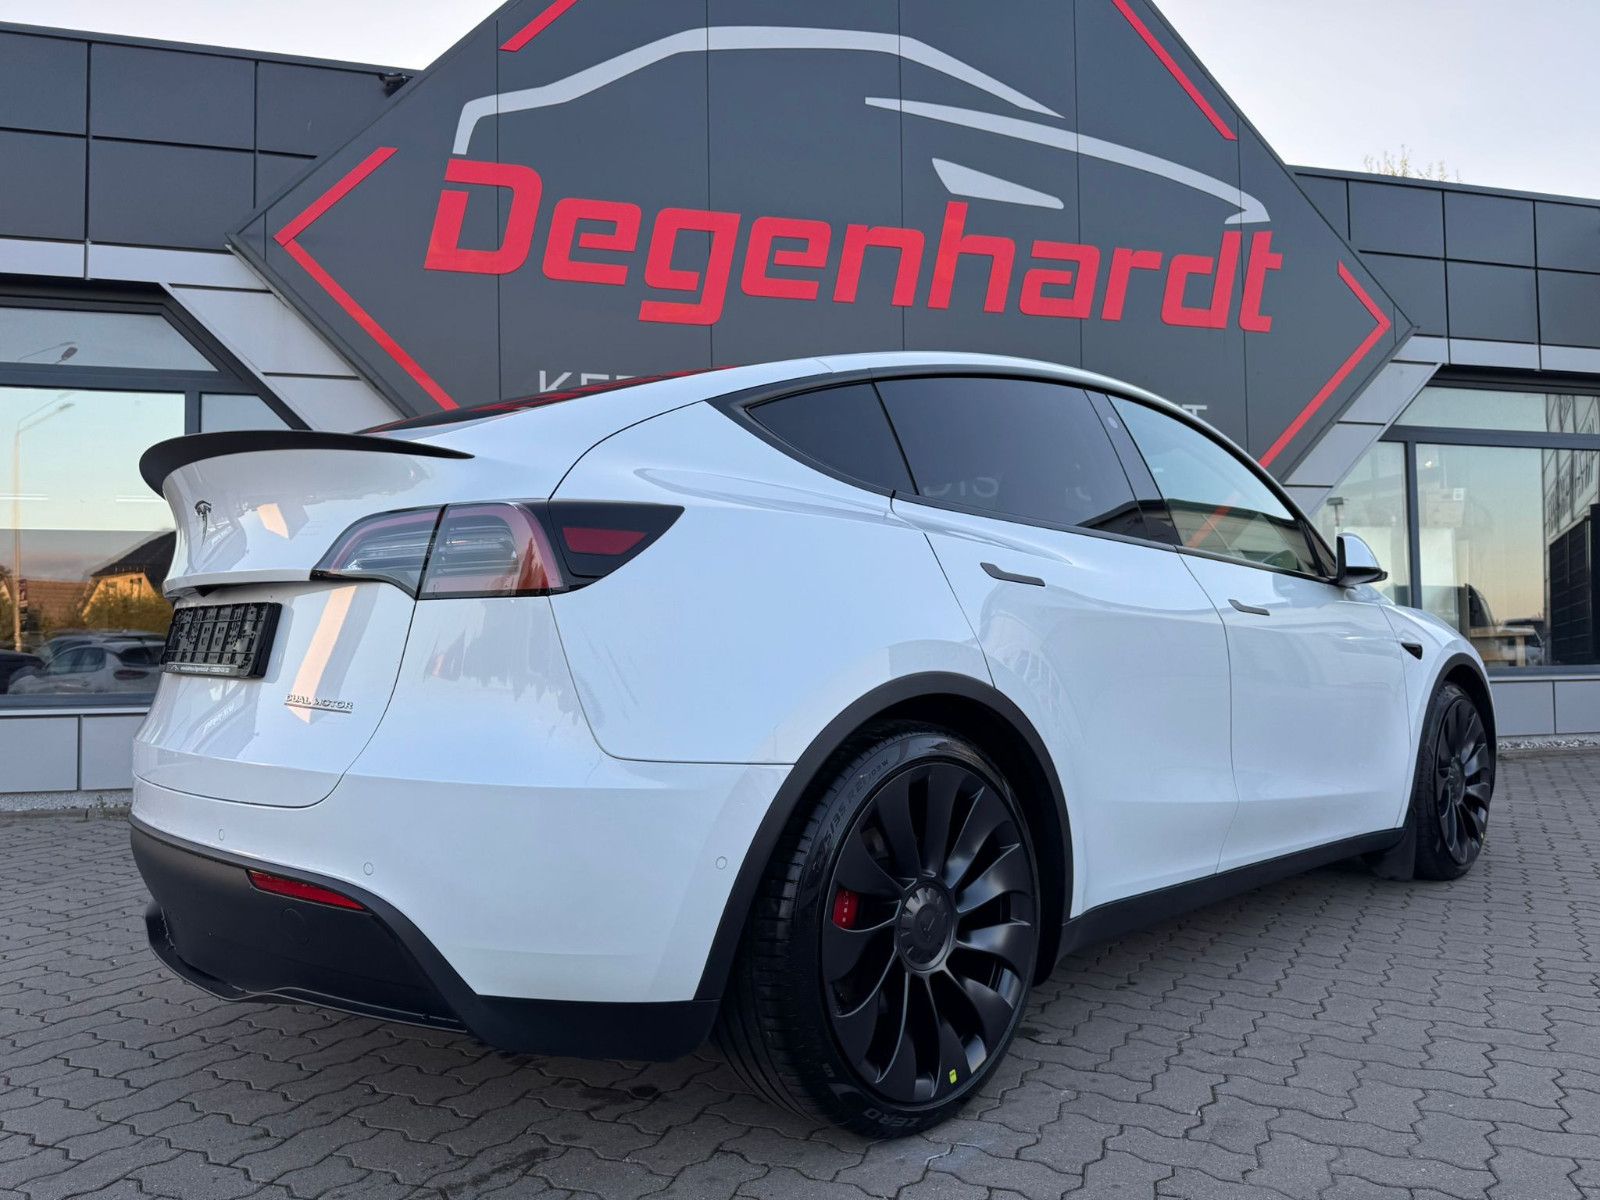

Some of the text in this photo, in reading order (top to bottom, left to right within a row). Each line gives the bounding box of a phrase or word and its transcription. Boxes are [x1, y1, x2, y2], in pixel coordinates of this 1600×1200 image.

[424, 157, 1283, 333] Degenhardt
[285, 694, 354, 711] DUAL MOTOR
[862, 1106, 922, 1128] ZERO
